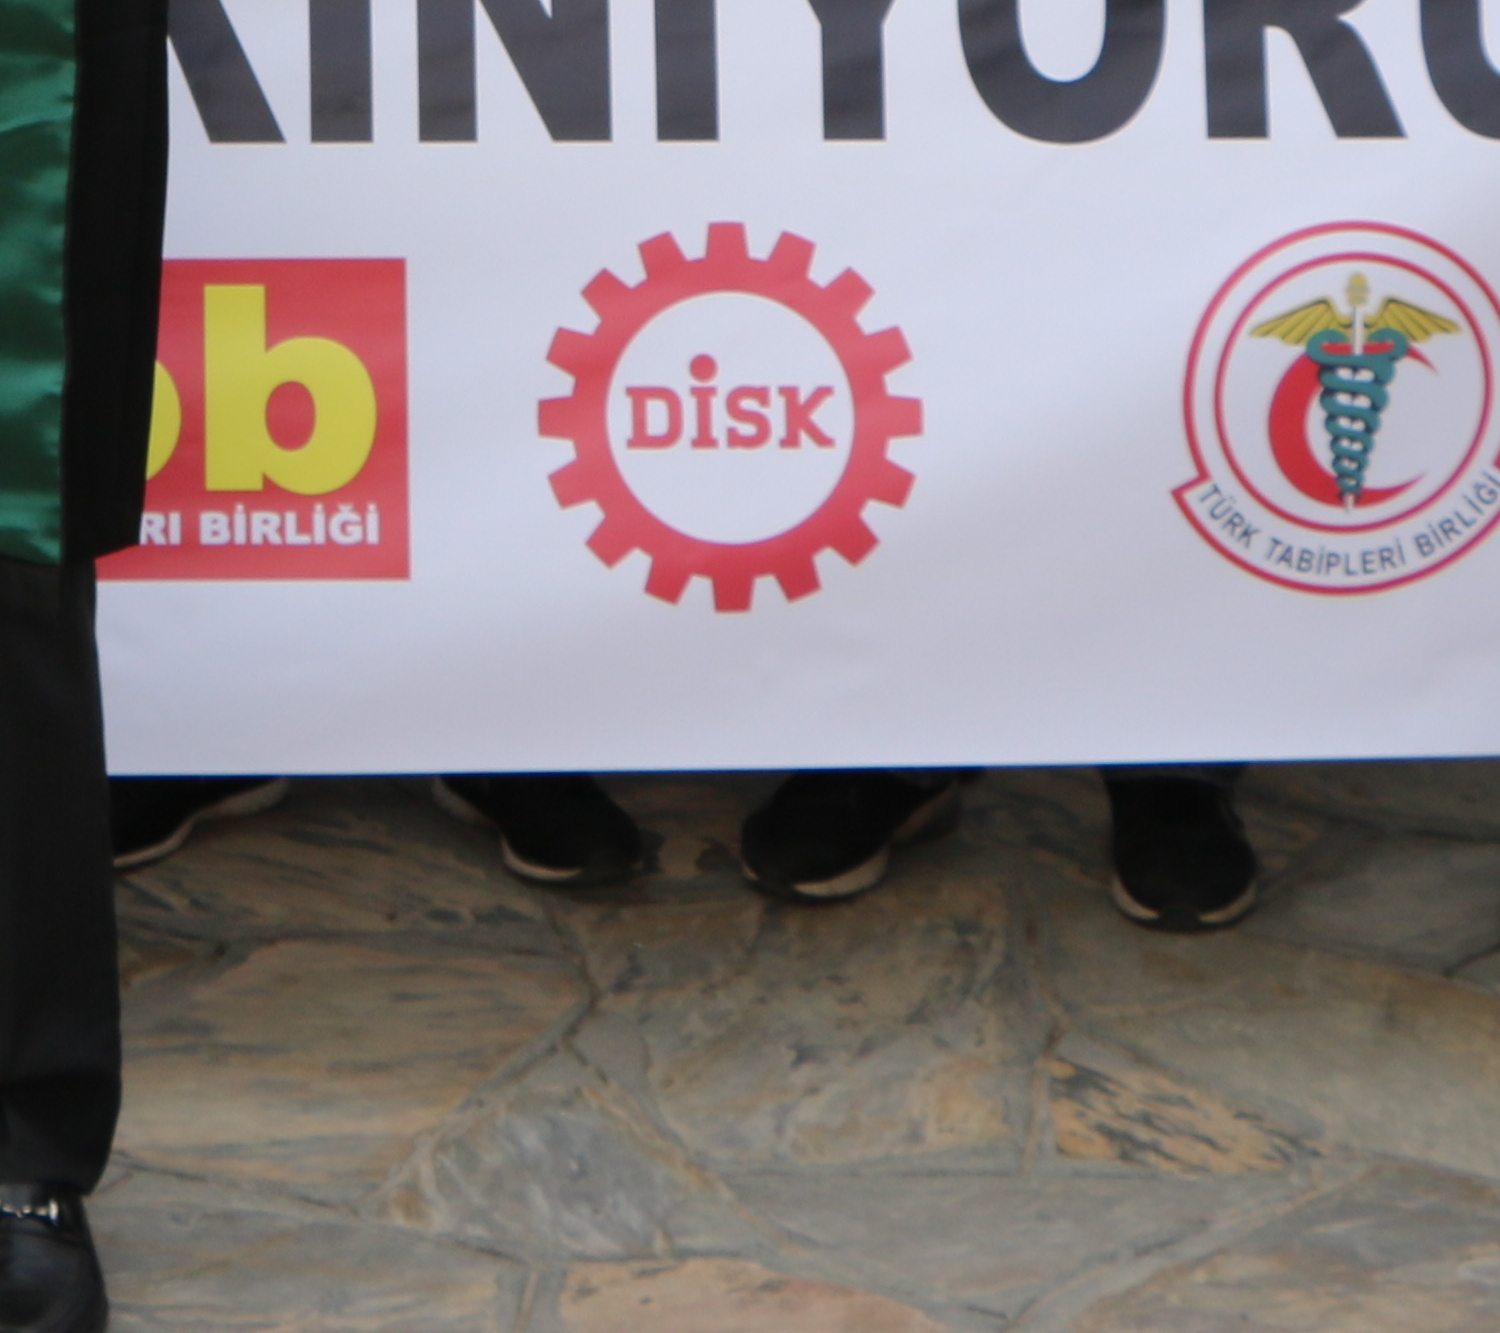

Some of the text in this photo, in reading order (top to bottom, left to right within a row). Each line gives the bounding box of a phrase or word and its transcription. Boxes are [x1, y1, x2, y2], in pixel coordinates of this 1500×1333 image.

[625, 352, 836, 450] DİSK
[199, 503, 381, 546] BİRLİĞİ
[1198, 481, 1262, 549] TÜRK
[1265, 535, 1406, 577] TABİPLERİ
